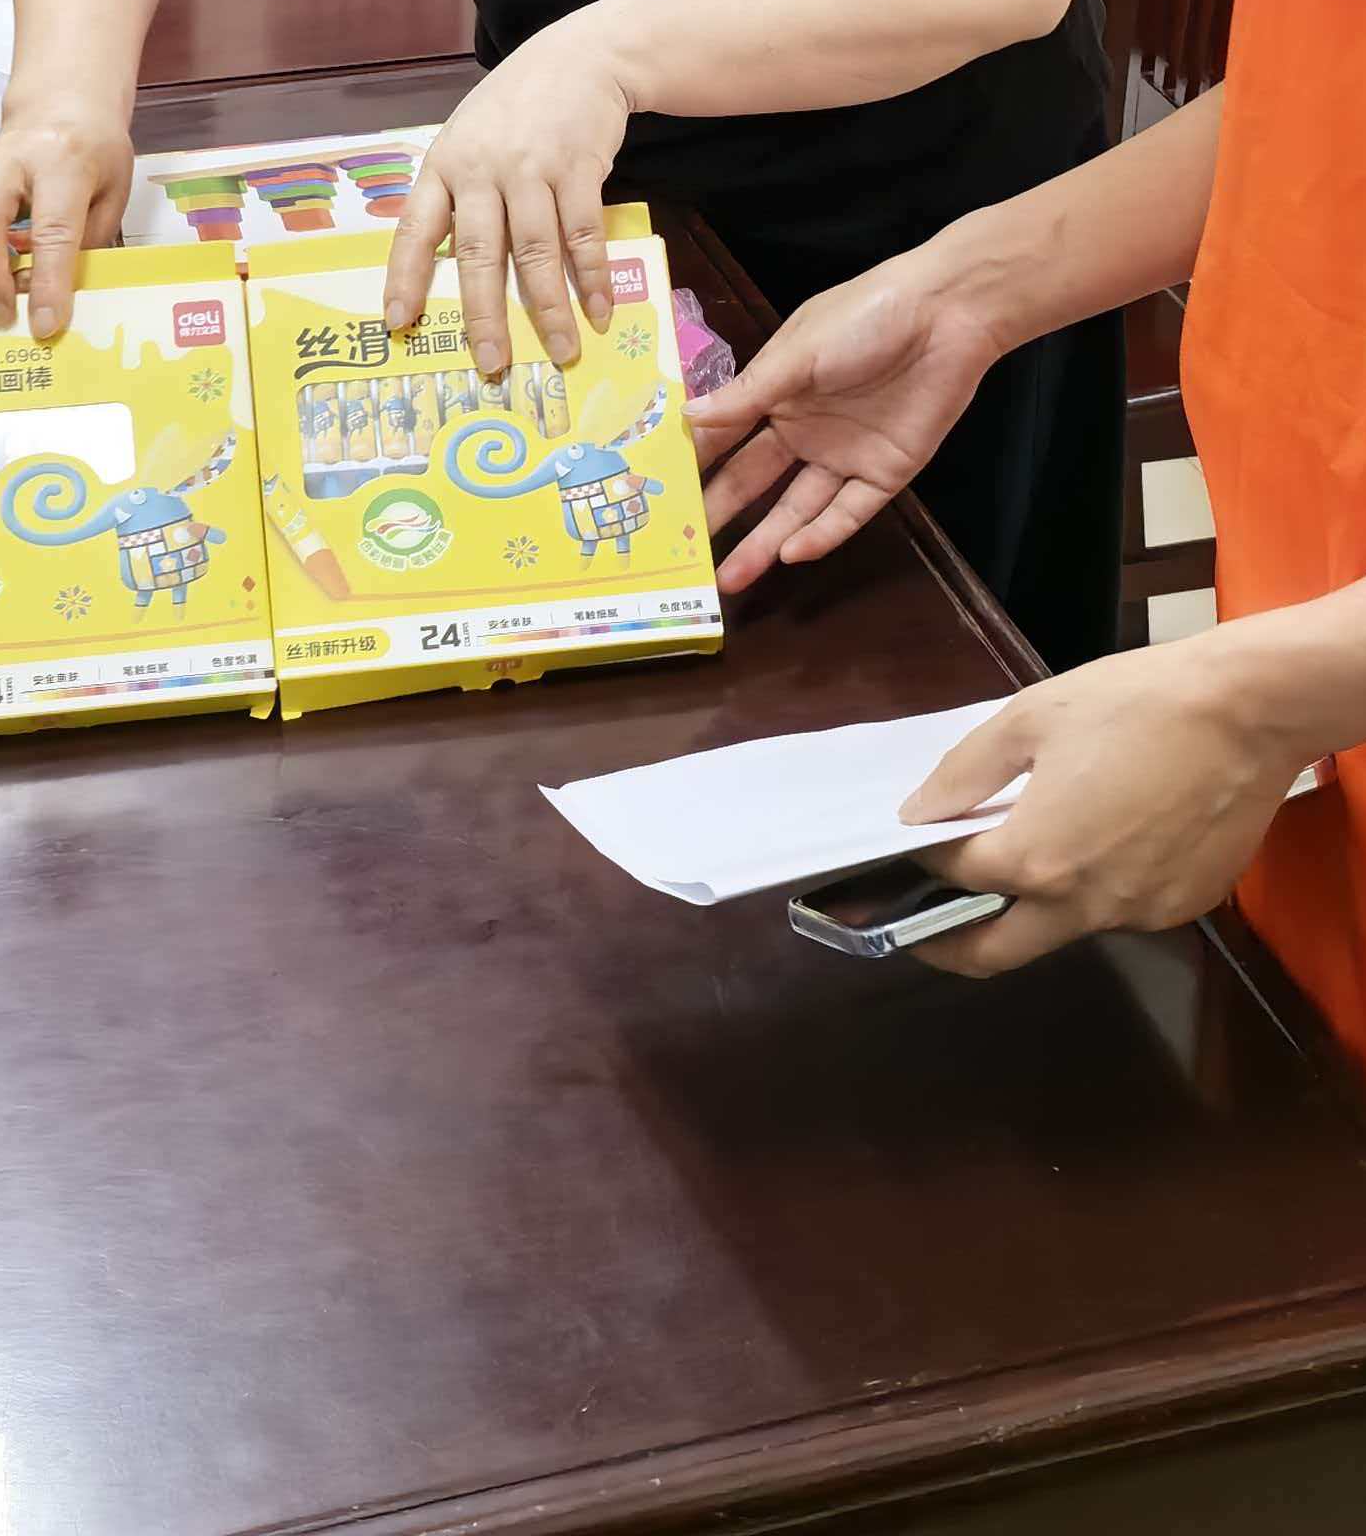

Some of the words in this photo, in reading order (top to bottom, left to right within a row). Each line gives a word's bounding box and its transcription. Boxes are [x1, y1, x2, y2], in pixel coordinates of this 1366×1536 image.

[612, 283, 644, 295] 力文具
[177, 309, 220, 326] deli
[293, 320, 392, 381] 丝滑
[285, 635, 377, 661] 丝滑新升级
[420, 622, 462, 651] 24
